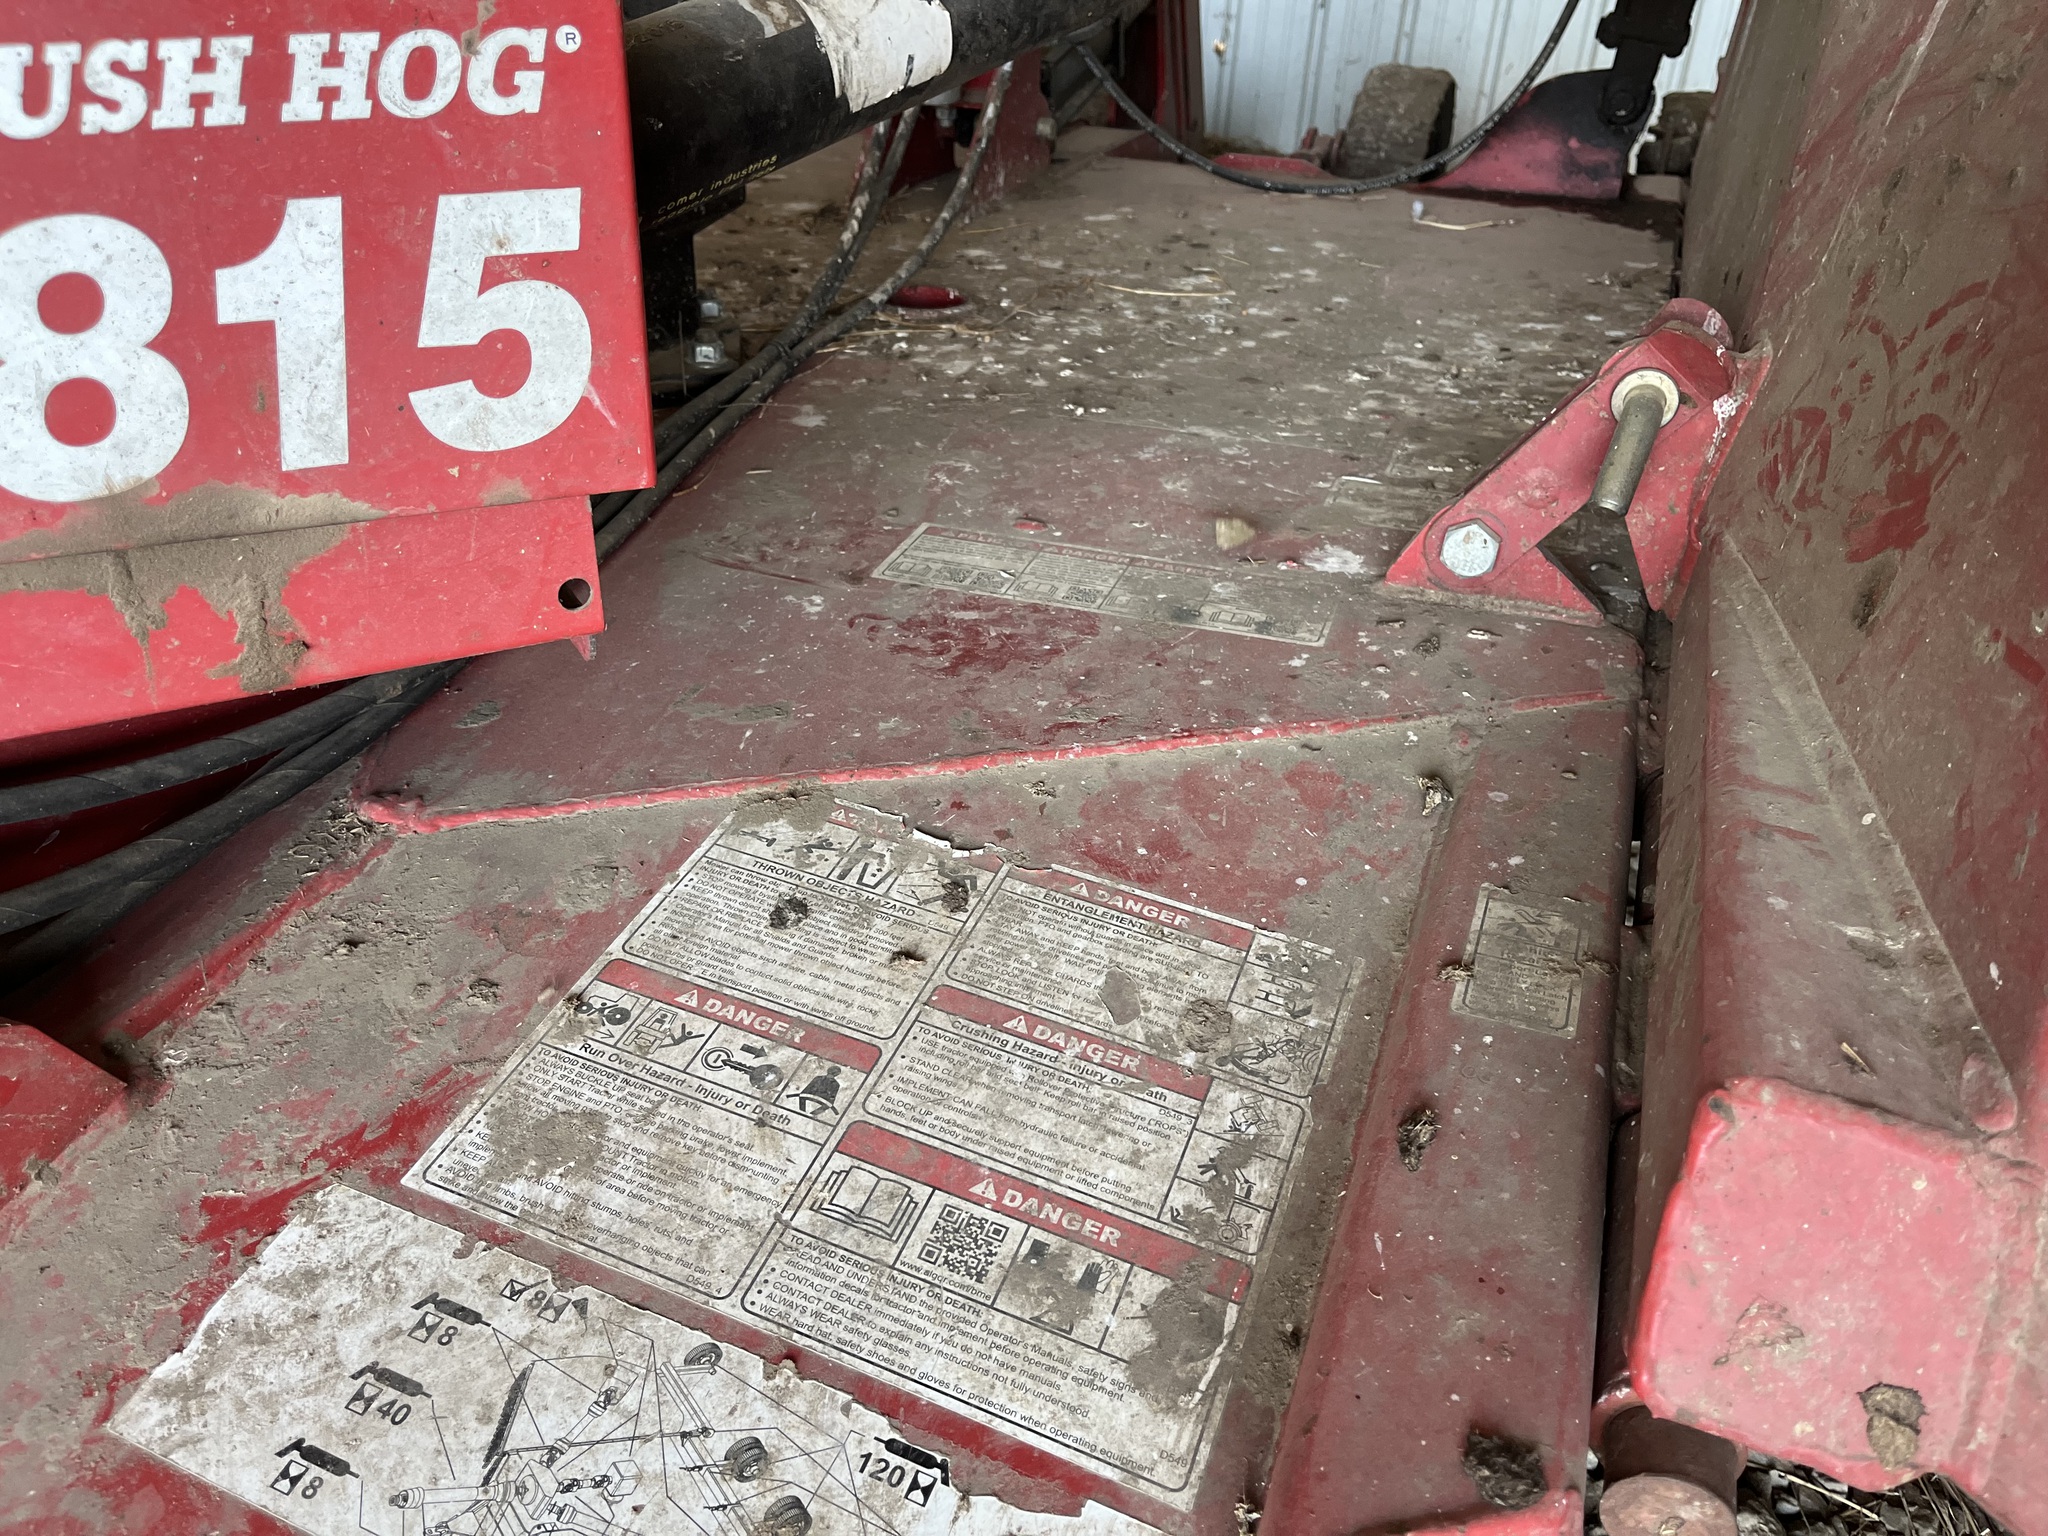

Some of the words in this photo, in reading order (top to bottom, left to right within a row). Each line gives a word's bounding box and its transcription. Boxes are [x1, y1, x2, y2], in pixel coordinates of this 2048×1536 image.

[0, 36, 254, 140] USH
[281, 28, 548, 122] HOG
[657, 188, 704, 215] comer
[710, 154, 778, 191] industries
[0, 187, 592, 503] 815
[751, 861, 804, 881] THROWN
[804, 877, 864, 900] OBJECTS
[863, 895, 916, 916] HAZARD
[1092, 889, 1192, 928] DANGER
[1042, 893, 1144, 930] ENTANGLEMENT
[1147, 926, 1201, 948] HAZARD
[635, 947, 650, 955] DO
[649, 952, 669, 961] NOT
[668, 958, 708, 975] OPERE
[717, 975, 752, 990] transport
[750, 987, 782, 1000] position
[792, 1001, 810, 1009] with
[810, 1007, 833, 1017] wings
[701, 998, 807, 1043] DANGER
[1031, 1024, 1141, 1071] DANGER
[537, 1047, 551, 1056] TO
[550, 1052, 580, 1066] AVOID
[579, 1062, 620, 1081] SERIOUS
[619, 1077, 653, 1093] INJURY
[653, 1089, 669, 1099] OR
[669, 1095, 704, 1112] DEATH:
[538, 1058, 575, 1075] ALWAYS
[574, 1071, 611, 1088] BUCKLE
[610, 1084, 626, 1093] UP
[625, 1091, 642, 1099] seat
[578, 1042, 606, 1058] Run
[606, 1052, 639, 1070] Over
[639, 1064, 686, 1086] Hazard
[694, 1084, 733, 1106] Injury
[733, 1100, 750, 1110] or
[751, 1104, 793, 1125] Death
[917, 1026, 930, 1034] TO
[931, 1031, 960, 1045] AVOID
[960, 1041, 1002, 1060] SERIOUS
[1041, 1069, 1056, 1079] OR
[1057, 1075, 1092, 1092] DEATH:
[950, 1020, 1009, 1048] Crushing
[1011, 1041, 1059, 1063] Hazard
[1109, 1077, 1124, 1086] or
[879, 1104, 907, 1119] hands,
[909, 1115, 927, 1125] feet
[938, 1126, 960, 1139] body
[961, 1135, 987, 1148] under
[988, 1145, 1016, 1158] raised
[1016, 1156, 1064, 1176] equipment
[1075, 1176, 1098, 1189] lifted
[1099, 1186, 1154, 1210] components
[884, 1096, 917, 1112] BLOCK
[917, 1108, 933, 1118] UP
[933, 1115, 951, 1124] and
[951, 1122, 987, 1139] securely
[988, 1135, 1022, 1150] support
[1023, 1148, 1070, 1168] equipment
[1071, 1164, 1099, 1179] before
[1100, 1176, 1132, 1193] putting
[444, 1165, 475, 1181] AVOID
[492, 1184, 516, 1200] limbs,
[518, 1195, 544, 1209] brush
[585, 1223, 640, 1250] overhanging
[640, 1245, 673, 1261] objects
[673, 1257, 694, 1269] that
[693, 1266, 711, 1277] can
[605, 1183, 626, 1194] area
[626, 1190, 655, 1205] before
[655, 1202, 688, 1220] moving
[688, 1214, 717, 1230] tractor
[717, 1227, 729, 1235] or
[1001, 1188, 1123, 1247] DANGER
[528, 1289, 548, 1309] 8
[788, 1234, 804, 1245] TO
[804, 1240, 837, 1258] AVOID
[838, 1254, 885, 1278] SERIOUS
[885, 1273, 924, 1294] INJURY
[925, 1289, 943, 1301] OR
[944, 1296, 983, 1318] DEATH:
[437, 1325, 459, 1346] 8
[765, 1292, 808, 1314] ALWAYS
[808, 1309, 842, 1328] WEAR
[841, 1325, 871, 1343] safety
[778, 1270, 829, 1295] CONTACT
[829, 1290, 872, 1313] DEALER
[872, 1308, 930, 1338] immediately
[931, 1331, 940, 1340] if
[938, 1337, 959, 1349] you
[959, 1343, 973, 1354] do
[974, 1351, 993, 1362] not
[993, 1357, 1017, 1372] have
[1018, 1369, 1062, 1392] manuals.
[821, 1260, 845, 1274] AND
[845, 1270, 918, 1304] UNDERSTAND
[918, 1299, 933, 1311] the
[934, 1307, 978, 1328] provided
[978, 1323, 1029, 1349] Operator's
[1030, 1344, 1074, 1370] Manuals,
[1077, 1365, 1107, 1383] safety
[1109, 1378, 1136, 1393] signs
[771, 1281, 822, 1307] CONTACT
[823, 1302, 866, 1325] DEALER
[866, 1320, 877, 1330] to
[877, 1326, 912, 1344] explain
[913, 1341, 932, 1354] any
[934, 1348, 990, 1377] instructions
[991, 1373, 1009, 1384] not
[1009, 1379, 1030, 1395] fully
[1031, 1390, 1090, 1419] understood.
[376, 1398, 412, 1426] 40
[758, 1303, 791, 1322] WEAR
[790, 1317, 815, 1332] hard
[815, 1327, 831, 1341] hat,
[834, 1337, 864, 1355] safety
[865, 1350, 894, 1366] shoes
[895, 1362, 916, 1375] and
[916, 1372, 950, 1390] gloves
[951, 1384, 966, 1396] for
[966, 1392, 1017, 1417] protection
[1018, 1414, 1047, 1430] when
[1048, 1426, 1097, 1453] operating
[1098, 1447, 1154, 1476] equipment.
[301, 1476, 324, 1499] 8
[858, 1451, 906, 1488] 120
[1159, 1450, 1188, 1468] D549
